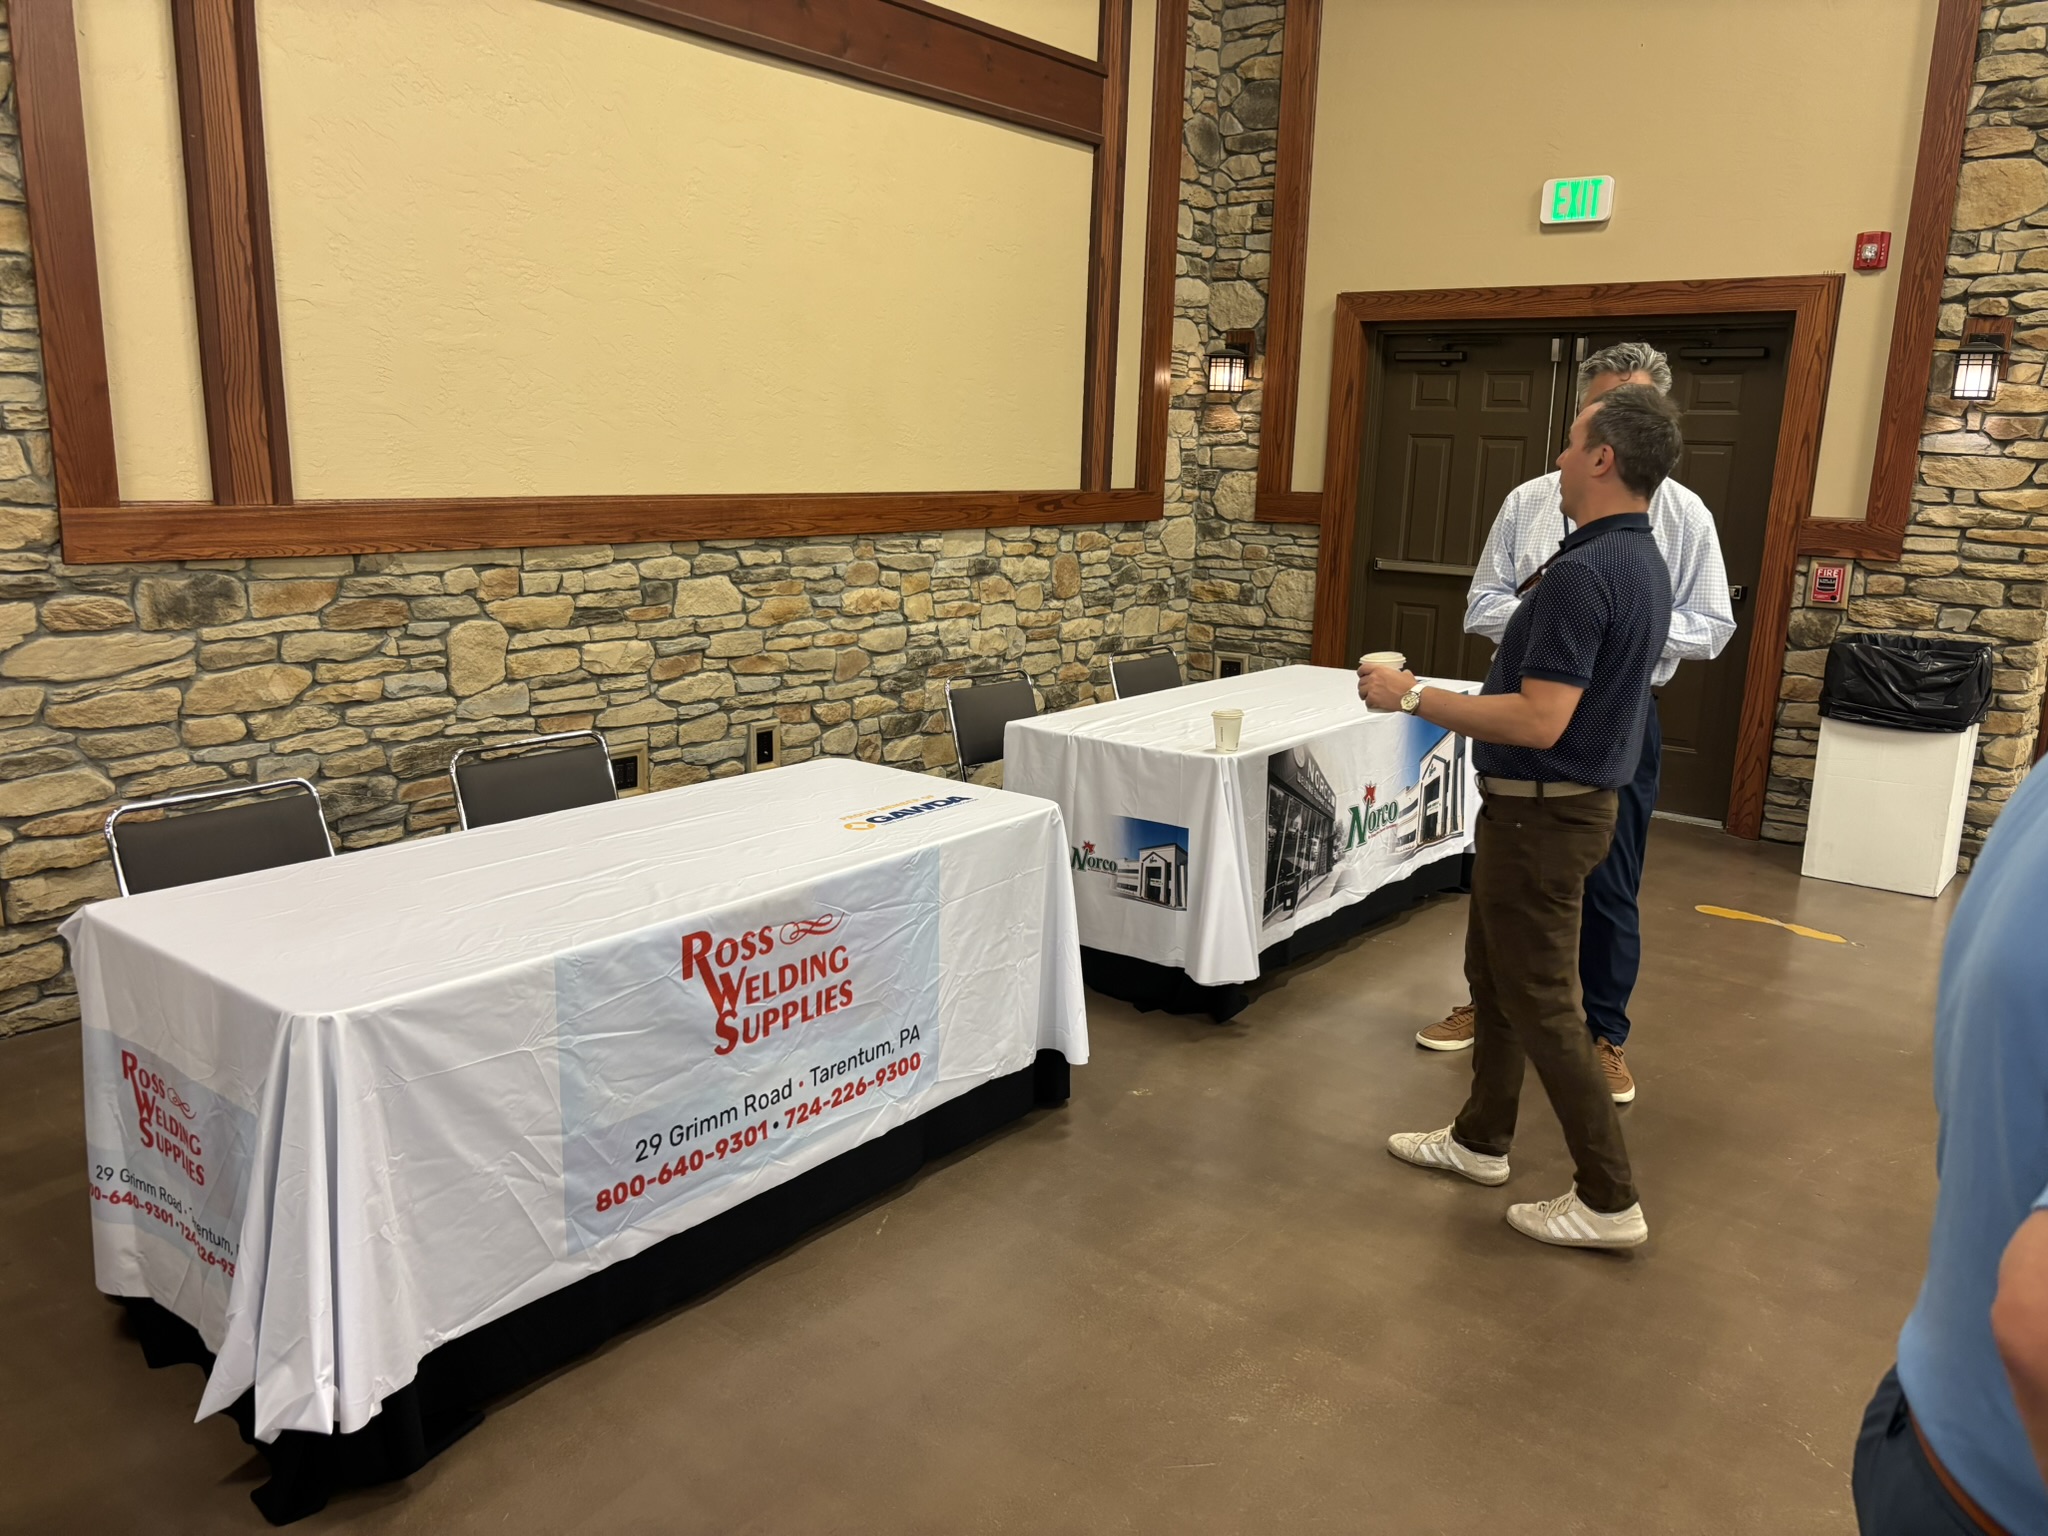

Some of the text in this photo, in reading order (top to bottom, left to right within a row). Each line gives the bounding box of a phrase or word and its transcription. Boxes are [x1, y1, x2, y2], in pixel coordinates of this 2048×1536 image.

[1552, 179, 1604, 221] EXIT
[1817, 568, 1840, 578] FIRE
[866, 795, 973, 824] GAWDA
[1343, 798, 1398, 853] Norco
[1071, 847, 1118, 872] Norco
[681, 926, 774, 1001] ROSS
[708, 945, 849, 1015] WELDING
[713, 979, 853, 1056] SUPPLIES
[121, 1050, 165, 1100] ROSS
[634, 1024, 921, 1163] 29 Grimm Road Tarentum, PA
[139, 1090, 202, 1156] WELDING
[139, 1118, 205, 1186] SUPPLIES
[595, 1052, 921, 1212] 800-640-9301 724-226-9300
[89, 1182, 236, 1278] 00-640-9301 724-26-93
[95, 1164, 114, 1181] 29
[119, 1168, 157, 1198] Grimm
[159, 1186, 182, 1214] Road
[189, 1207, 234, 1256] entum,
